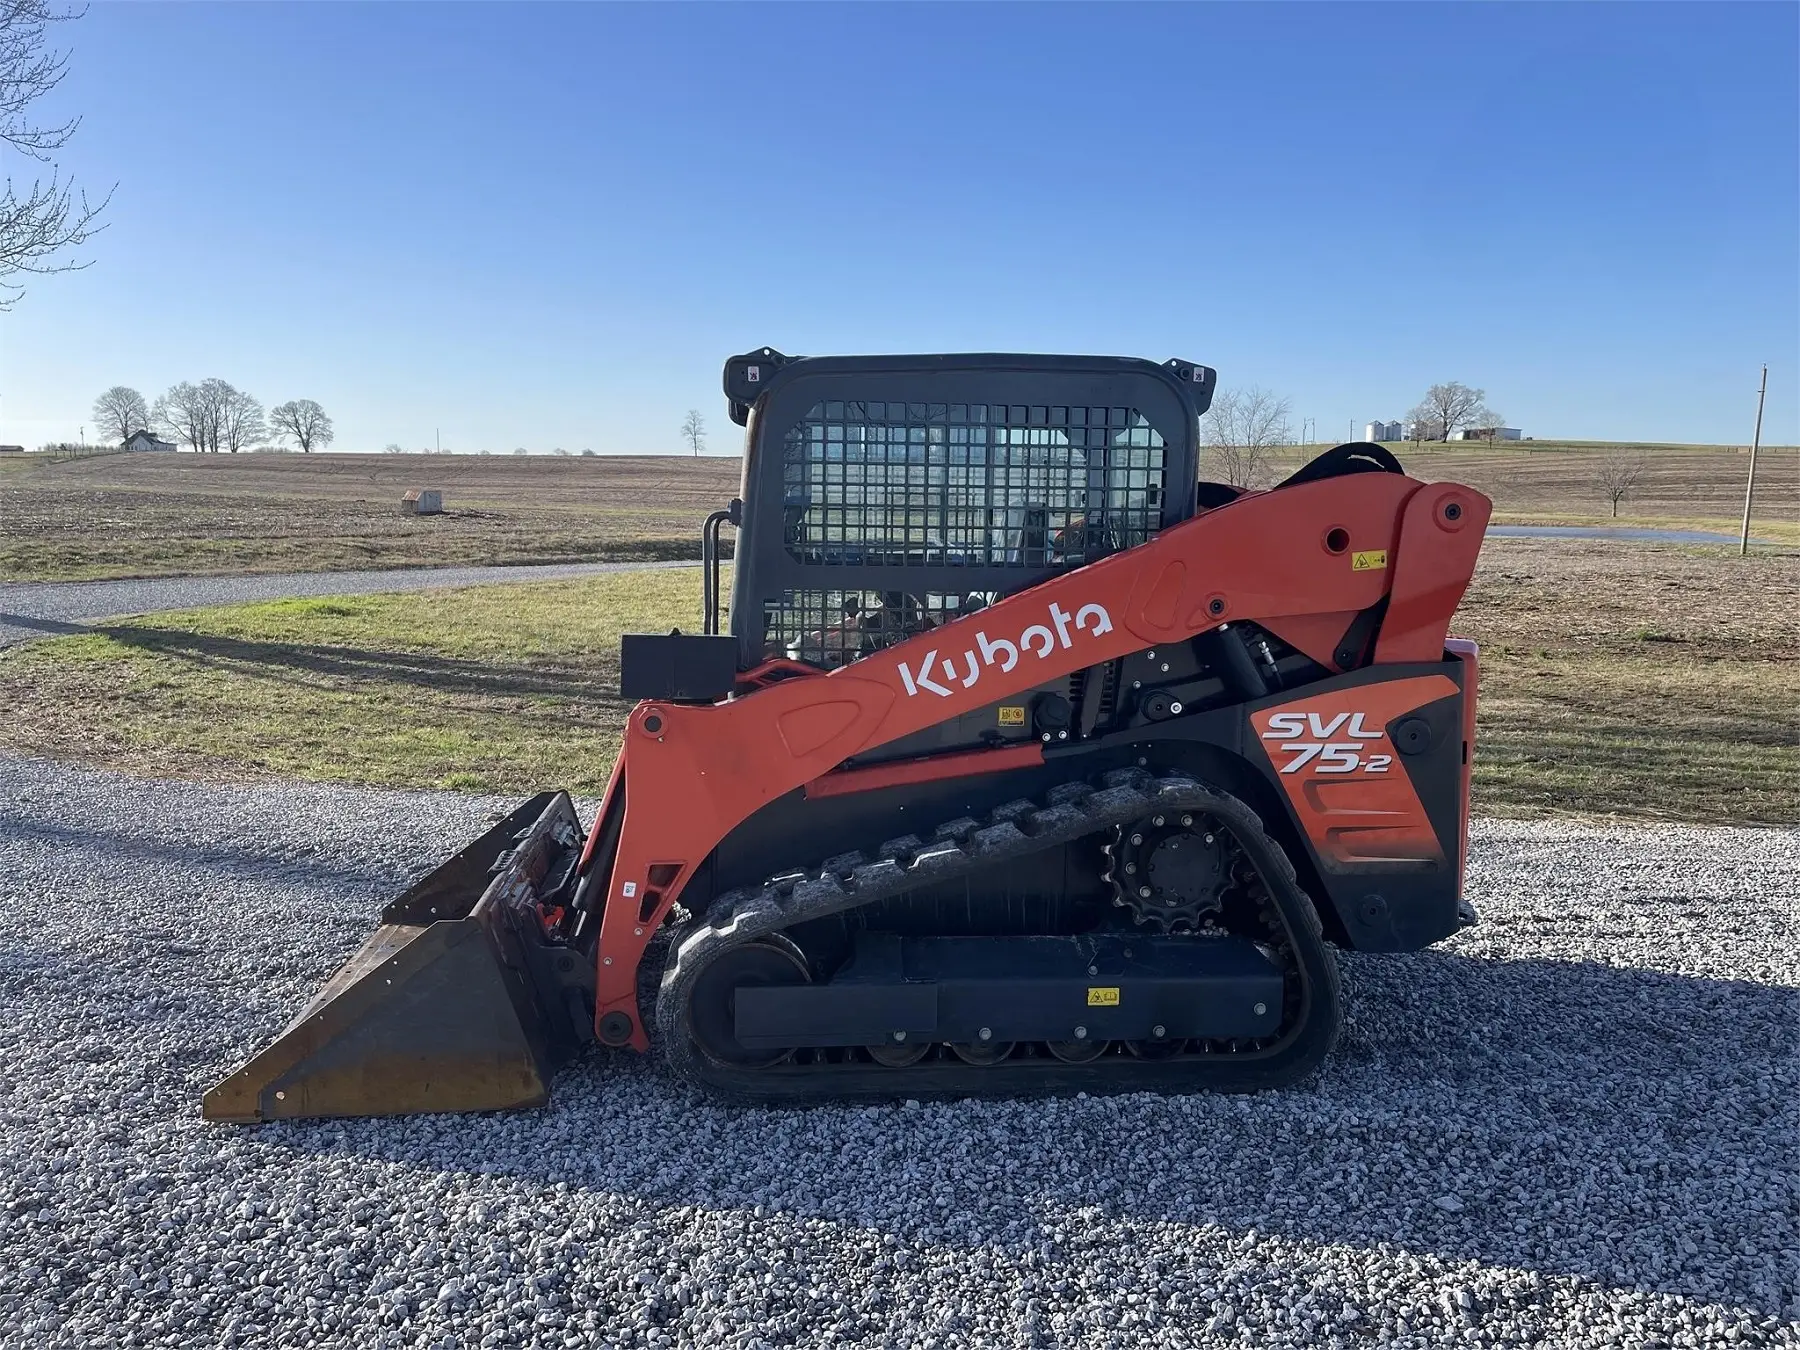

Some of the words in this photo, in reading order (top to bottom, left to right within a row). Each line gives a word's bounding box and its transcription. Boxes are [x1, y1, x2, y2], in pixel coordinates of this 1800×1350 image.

[897, 602, 1114, 697] Kubota
[1262, 712, 1384, 738] SVL
[1279, 743, 1392, 773] 75-2
